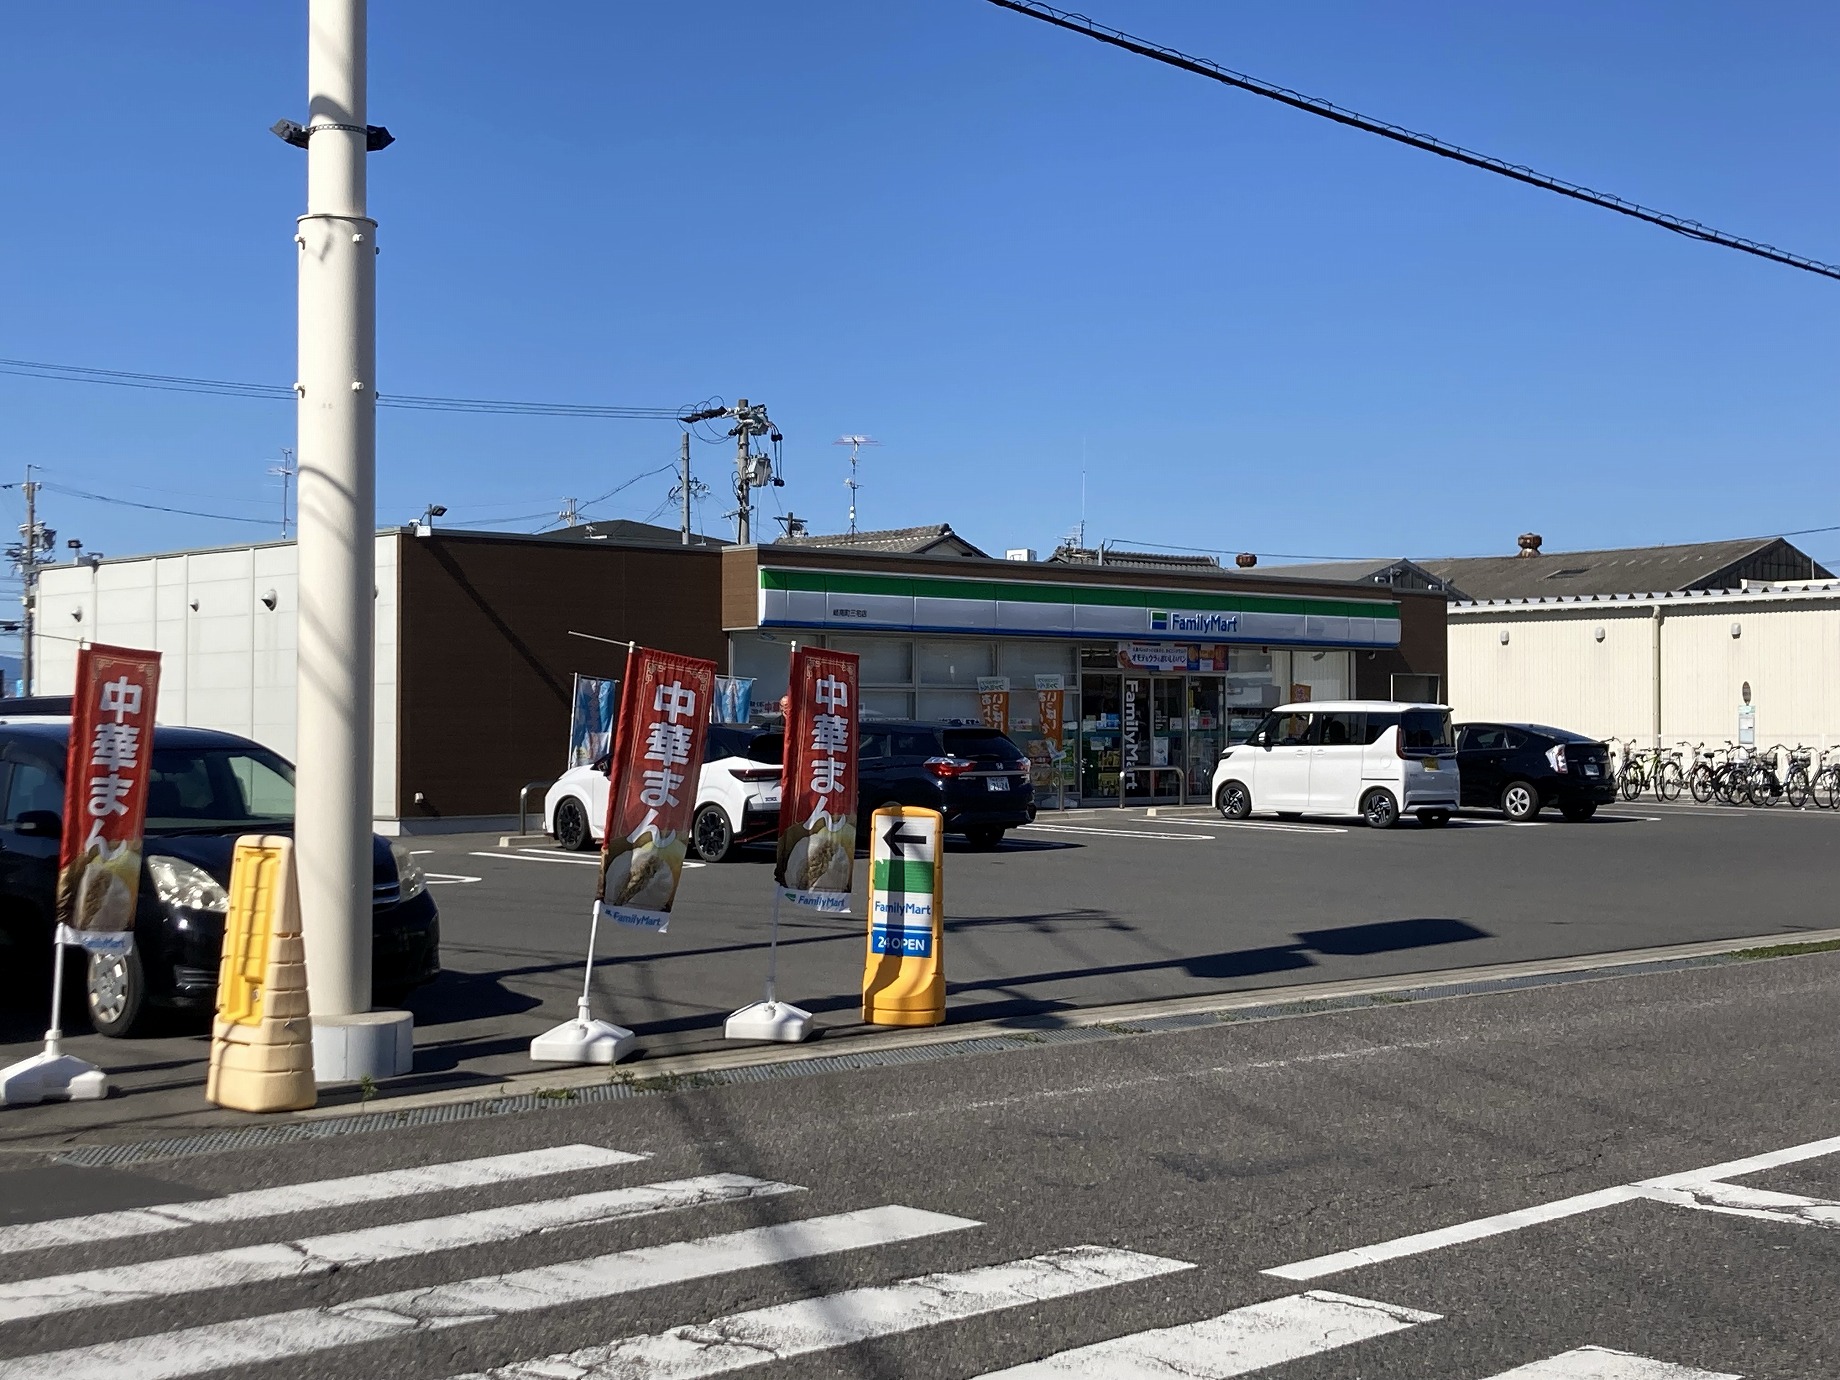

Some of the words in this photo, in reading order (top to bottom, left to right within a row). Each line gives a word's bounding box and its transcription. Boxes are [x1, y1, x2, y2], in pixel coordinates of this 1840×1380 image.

[1171, 612, 1238, 633] FamilyMart
[1124, 680, 1139, 790] FamilyMart
[626, 680, 696, 848] 中華まん
[803, 674, 848, 833] 中華まん
[84, 675, 142, 860] 中華まん
[797, 895, 845, 907] FamilyMart
[875, 900, 931, 916] FamilyMart
[613, 911, 661, 925] FamilyMart
[891, 937, 926, 951] OPEN
